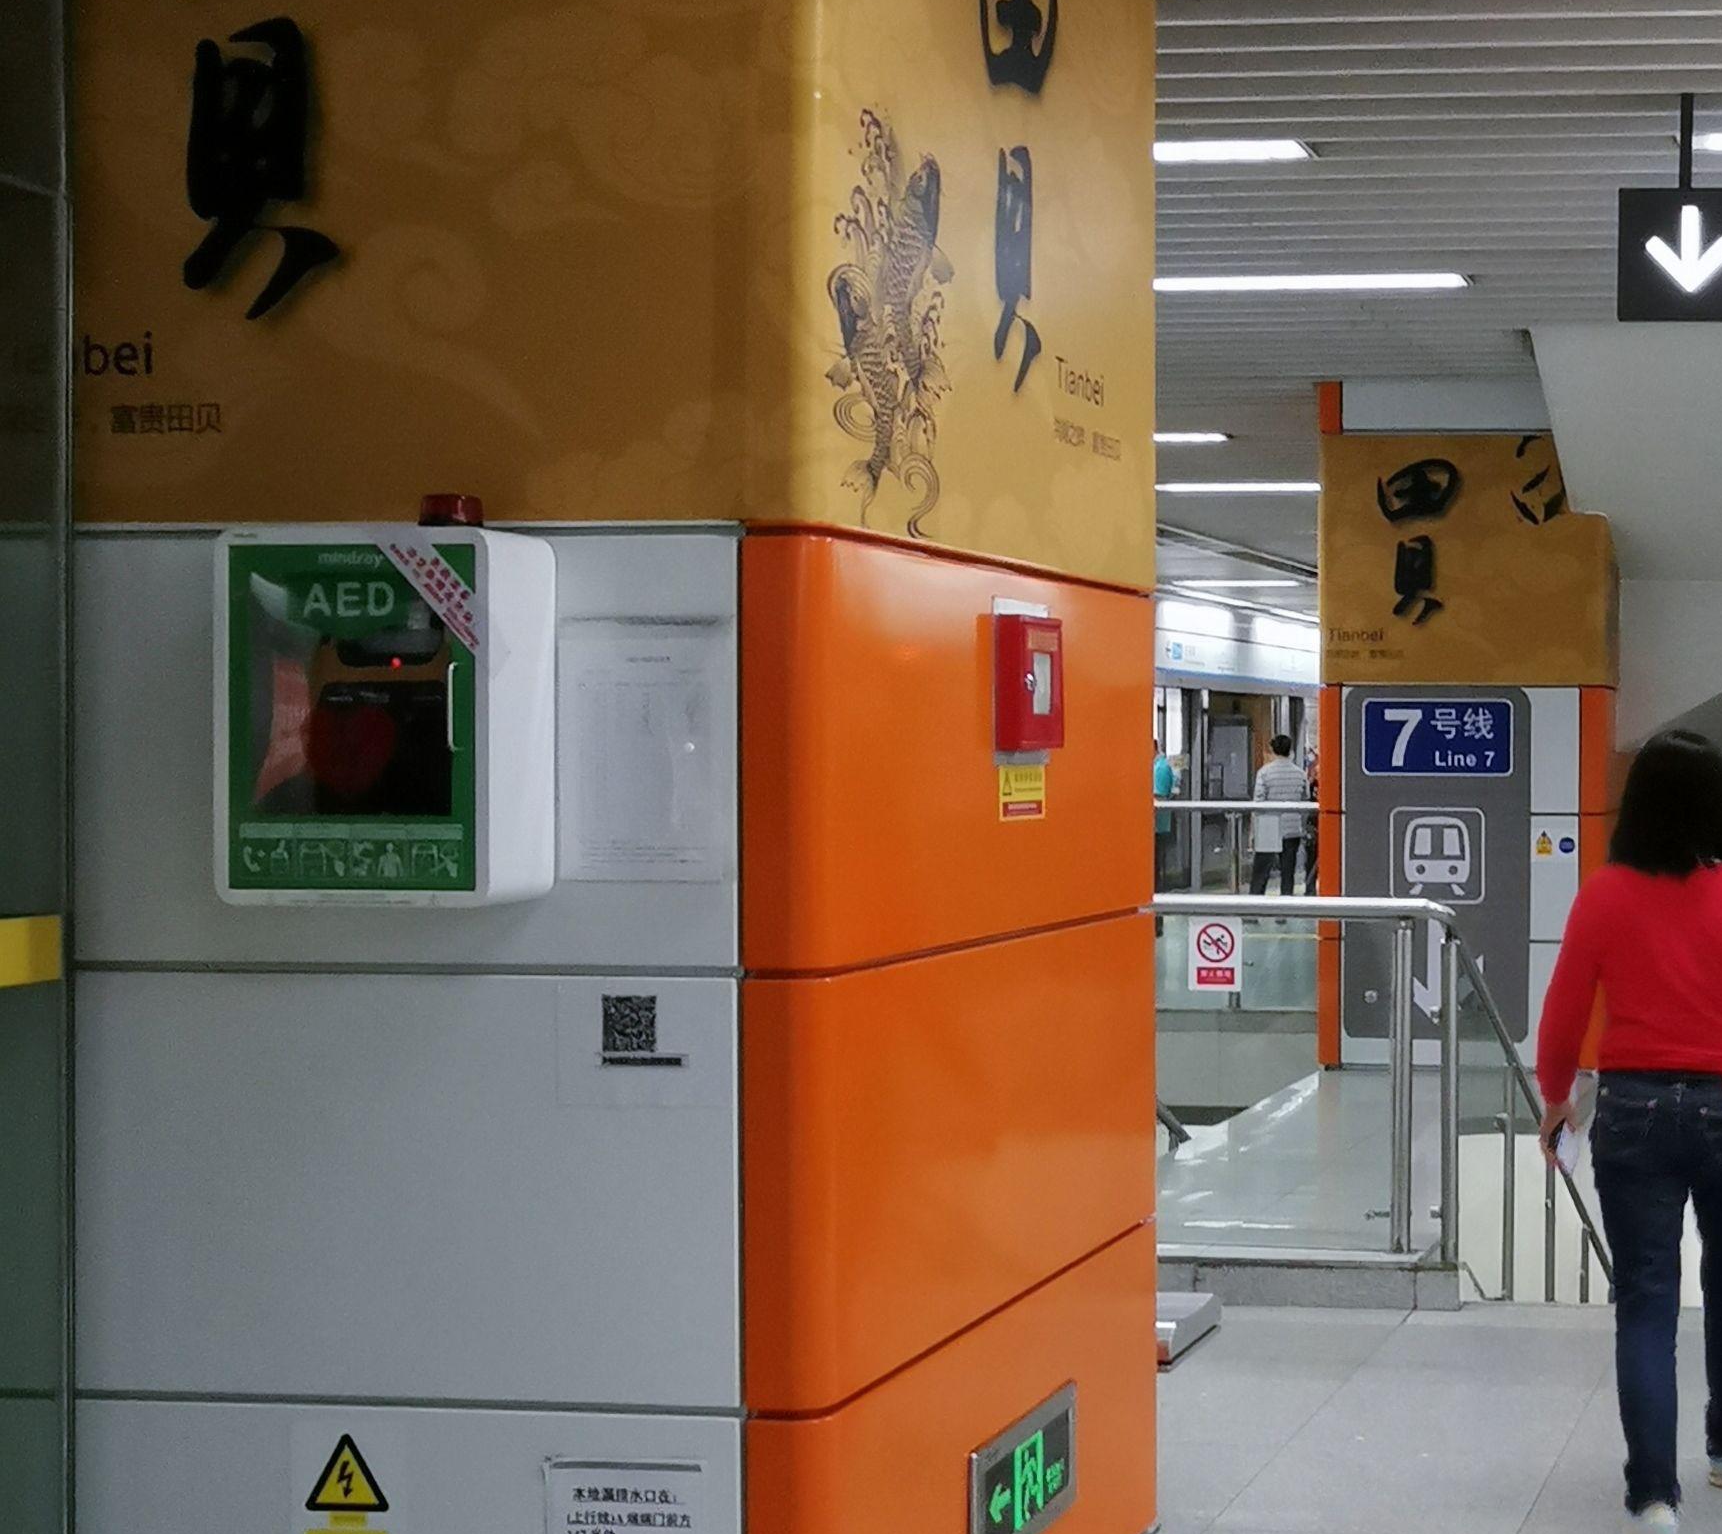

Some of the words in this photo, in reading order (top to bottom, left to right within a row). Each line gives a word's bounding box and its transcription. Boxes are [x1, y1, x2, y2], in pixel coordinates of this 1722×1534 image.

[303, 581, 395, 618] AED
[1434, 750, 1477, 767] Line
[1484, 751, 1495, 767] 7
